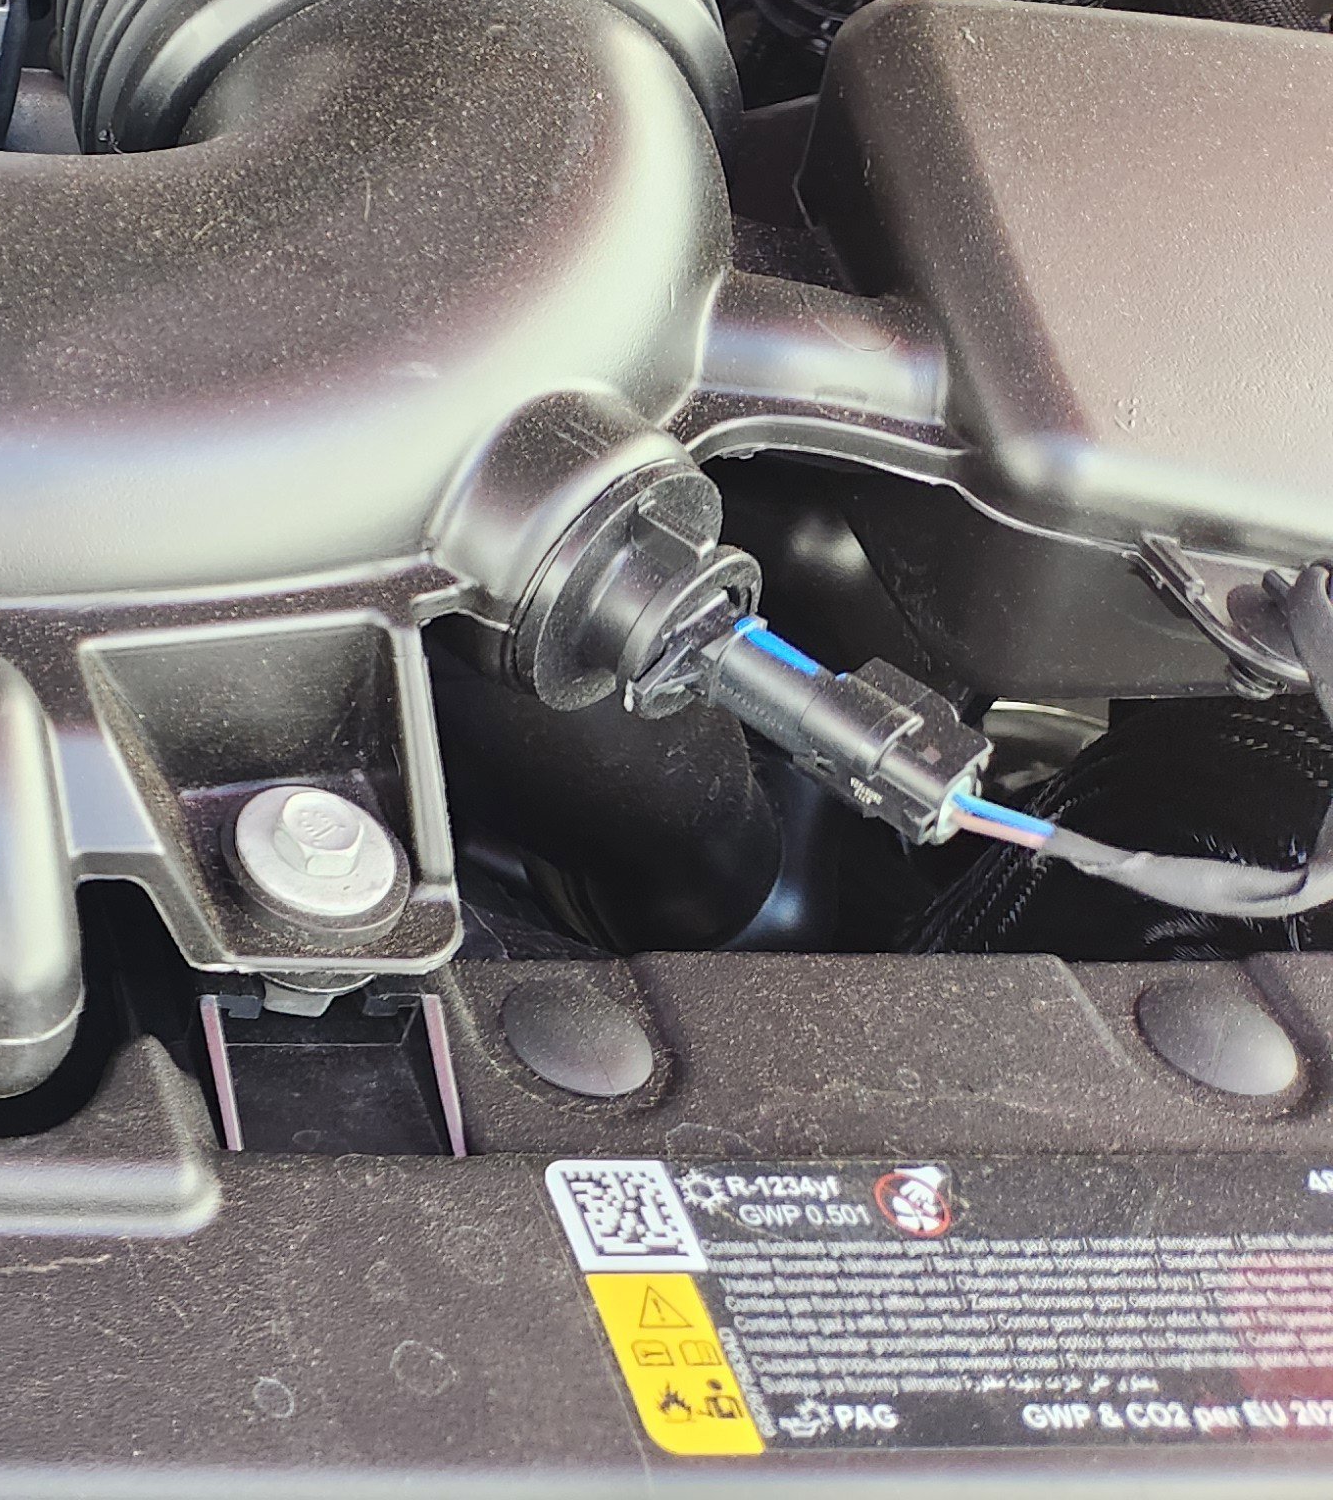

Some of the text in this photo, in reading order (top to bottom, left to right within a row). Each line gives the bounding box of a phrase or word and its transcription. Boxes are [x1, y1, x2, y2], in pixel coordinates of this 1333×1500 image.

[725, 1175, 841, 1202] R-1234yf
[738, 1203, 871, 1227] GWP 0.501
[834, 1404, 898, 1431] PAG
[1022, 1401, 1091, 1430] GWP
[1097, 1401, 1124, 1429] &
[1125, 1401, 1192, 1429] CO2
[1193, 1404, 1242, 1433] per
[1242, 1399, 1289, 1427] EU
